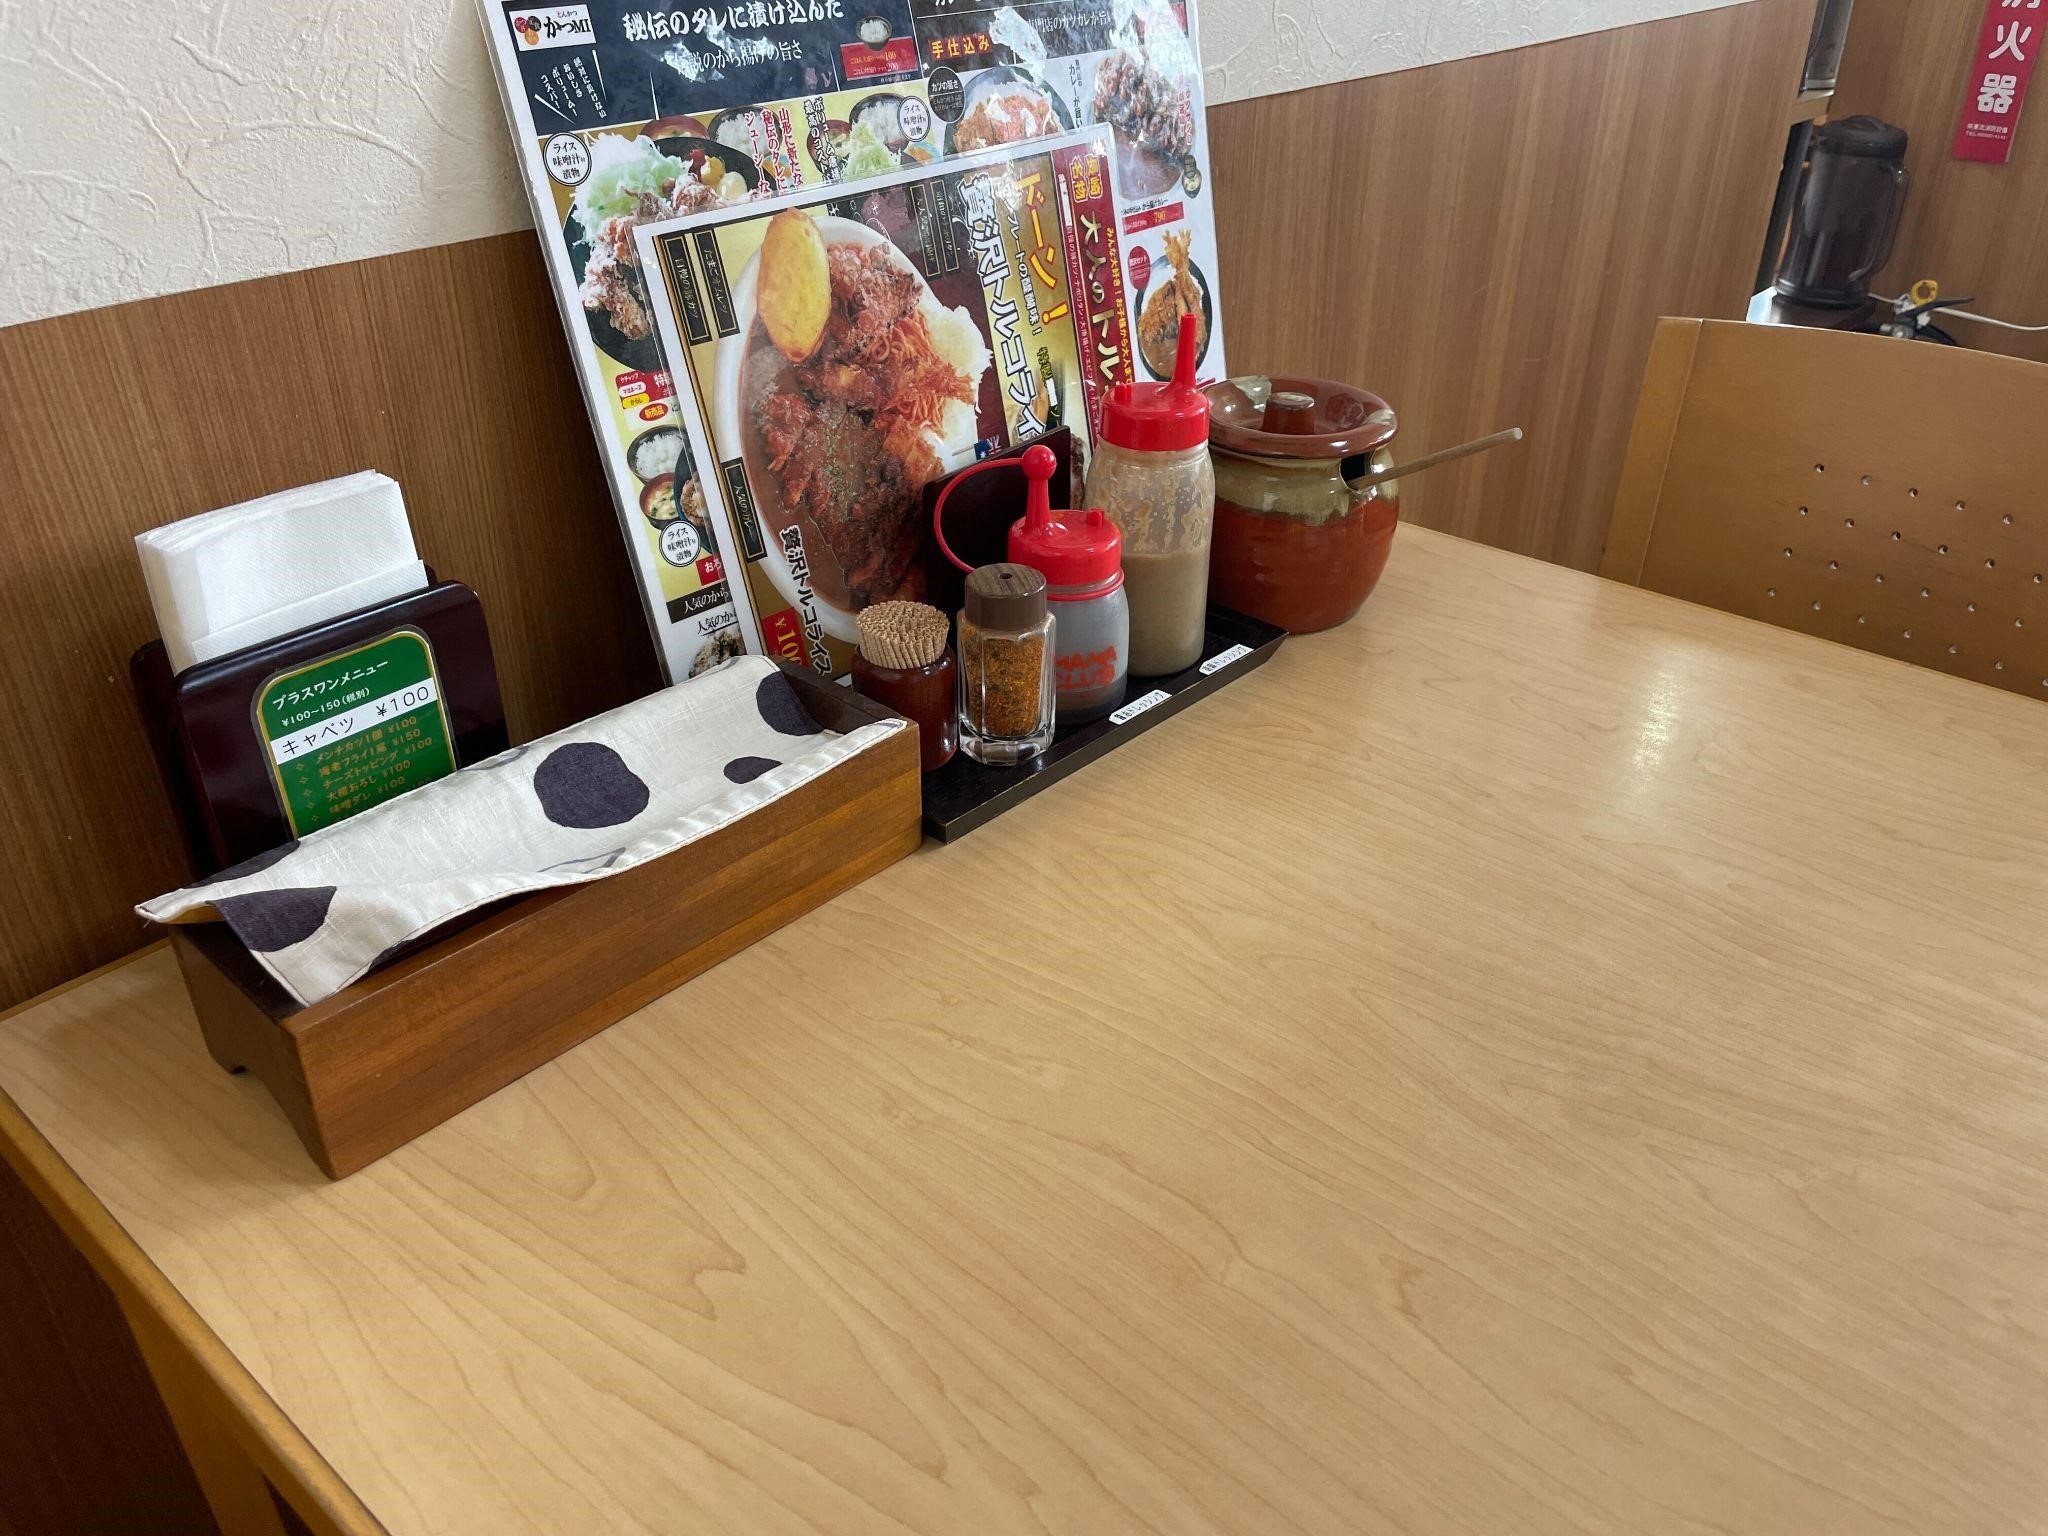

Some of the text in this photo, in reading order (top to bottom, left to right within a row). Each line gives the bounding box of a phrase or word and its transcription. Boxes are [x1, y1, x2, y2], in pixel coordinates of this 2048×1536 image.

[931, 34, 990, 58] 手仕込み
[1977, 0, 2041, 114] 火器
[553, 141, 577, 153] ライス
[958, 172, 1044, 437] 贅沢トルコライ
[667, 527, 689, 541] ライス
[272, 661, 389, 710] プラスワンメニュー
[282, 686, 429, 755] キャベツ ¥100
